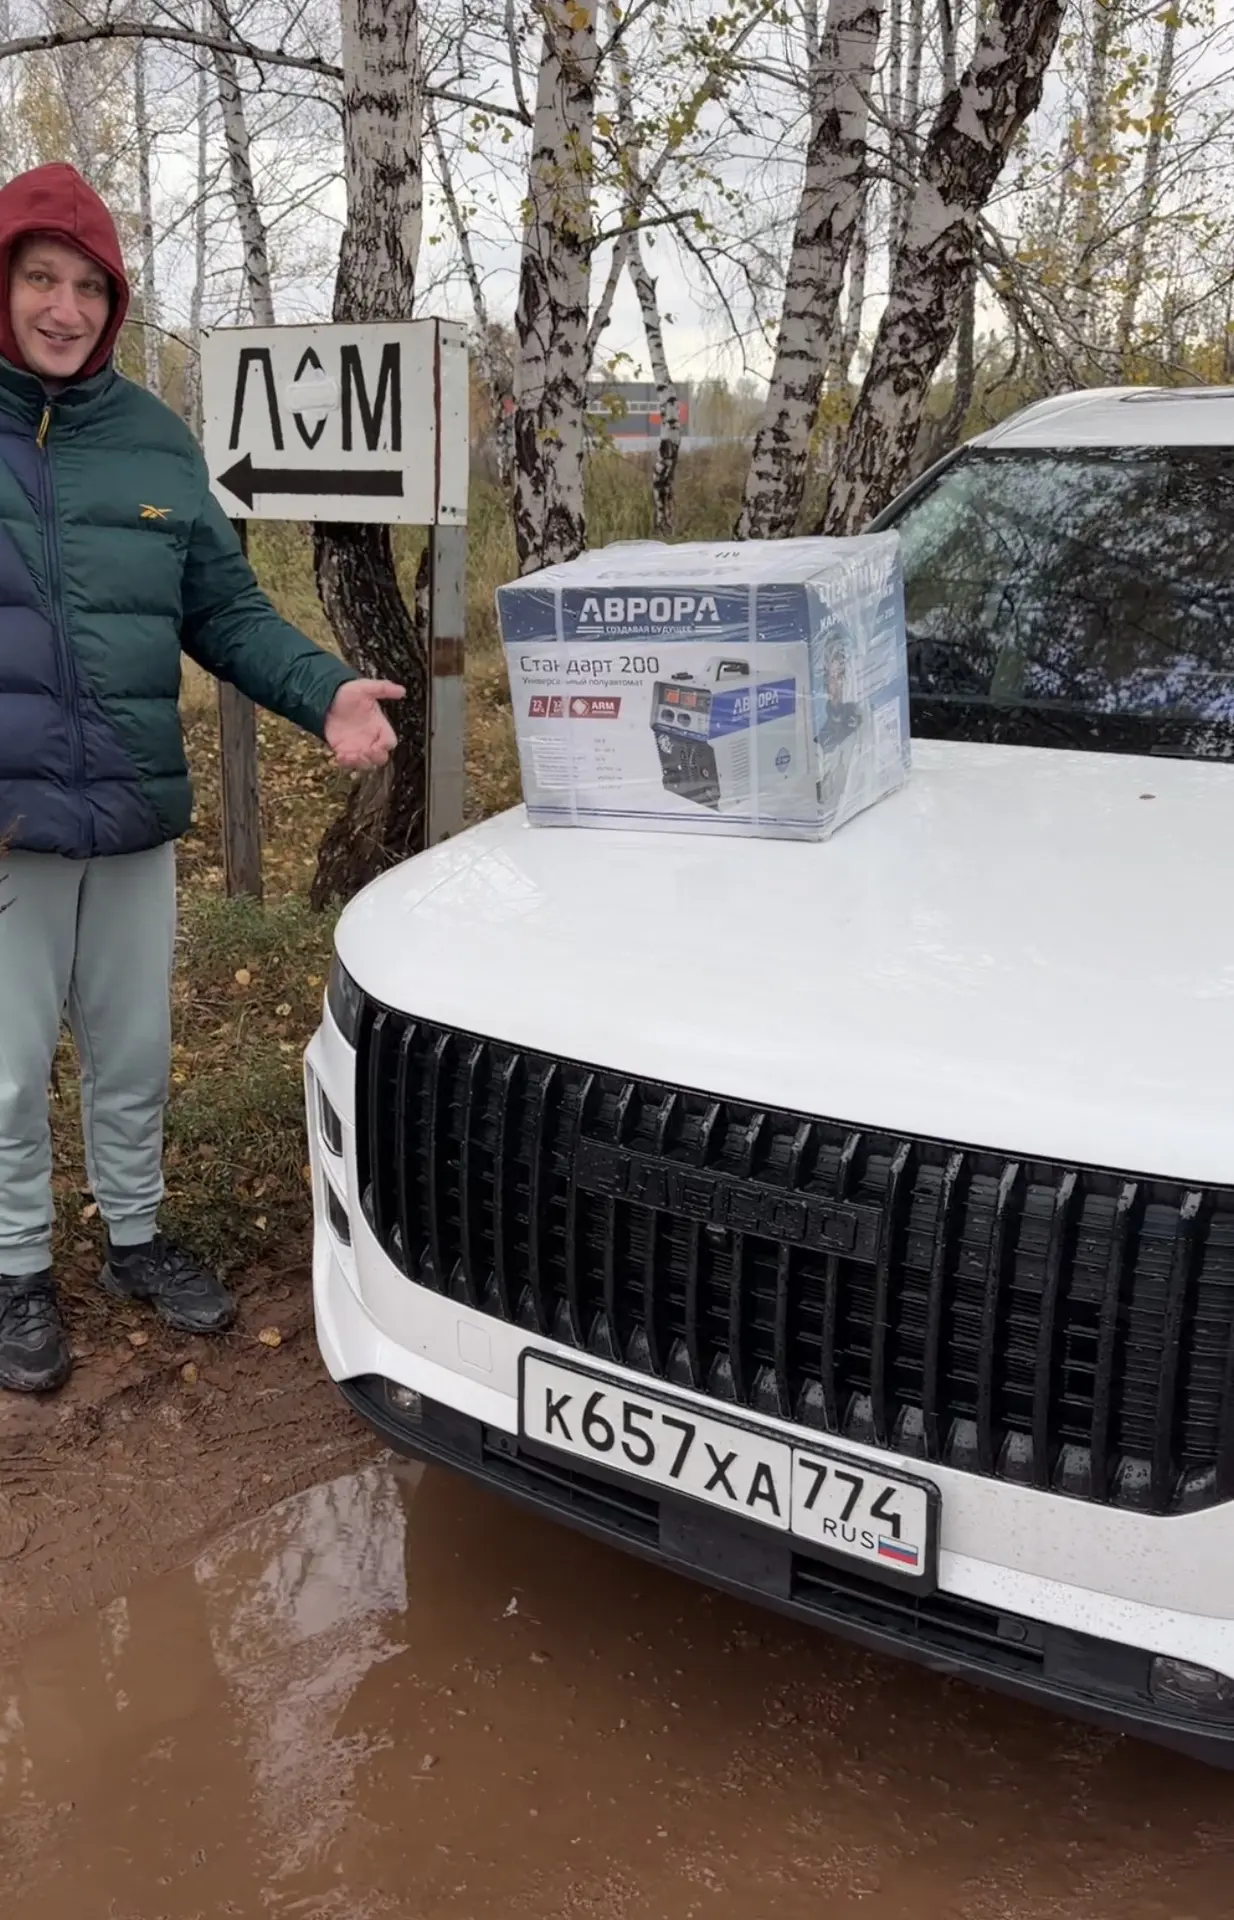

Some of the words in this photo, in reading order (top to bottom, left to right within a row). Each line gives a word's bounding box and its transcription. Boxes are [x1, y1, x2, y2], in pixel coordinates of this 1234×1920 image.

[579, 596, 721, 623] АВРОРА
[606, 626, 649, 635] СОЗДАВАЯ
[651, 626, 692, 635] БУДУЩЕЕ
[619, 656, 660, 674] 200
[592, 701, 615, 710] ARM
[798, 1458, 902, 1539] 774
[823, 1517, 875, 1550] RUS
